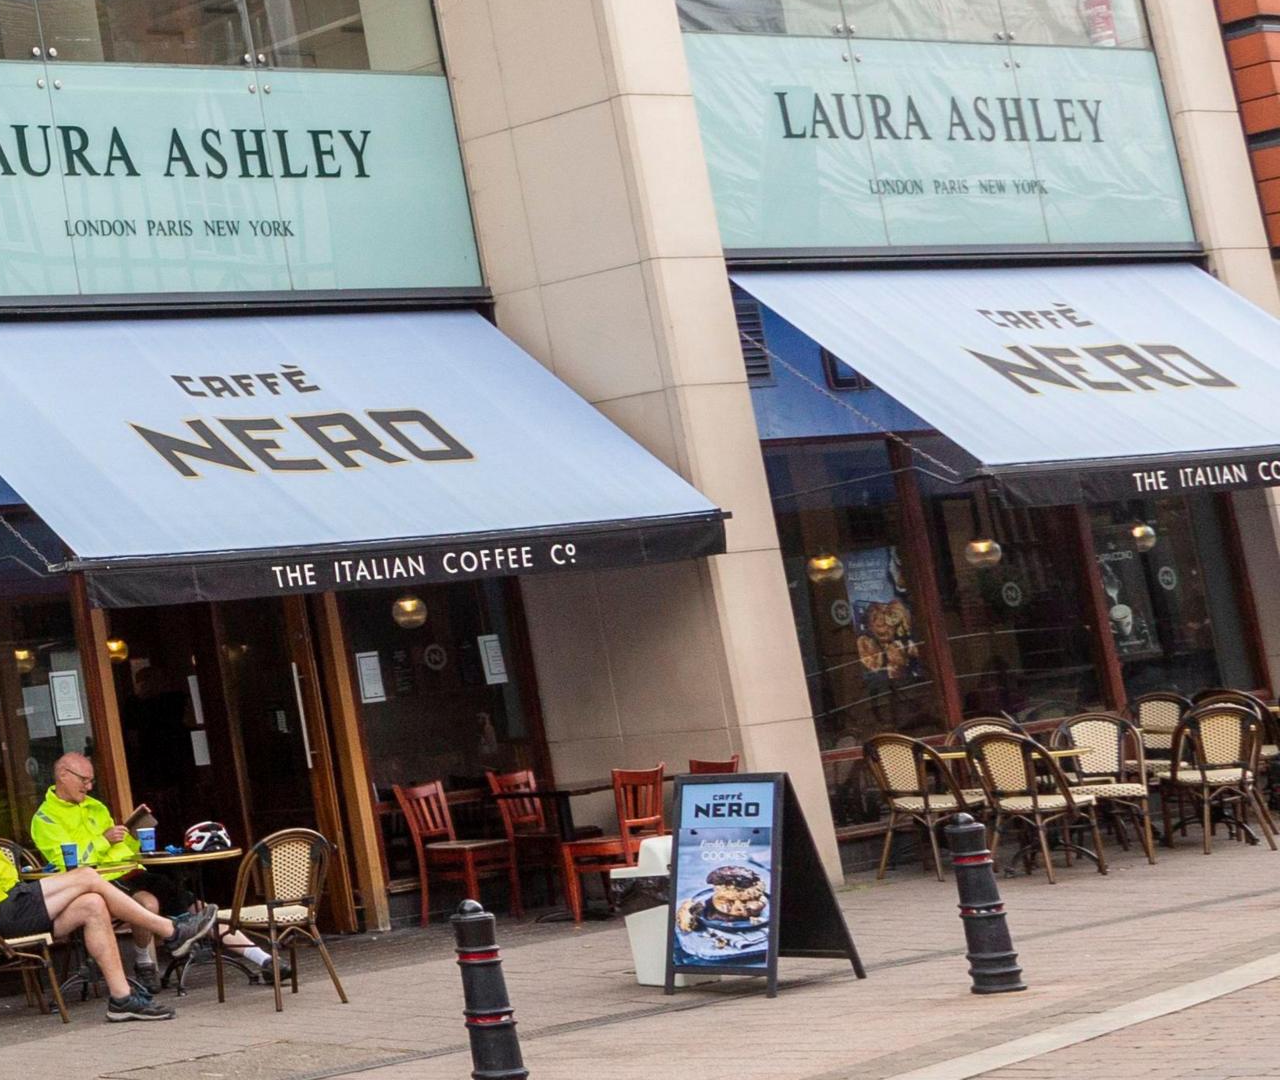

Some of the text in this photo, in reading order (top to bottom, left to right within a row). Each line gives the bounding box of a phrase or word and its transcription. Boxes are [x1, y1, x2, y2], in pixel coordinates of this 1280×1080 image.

[774, 91, 1104, 144] LAURA ASHLEY
[164, 128, 372, 179] ASHLEY
[869, 178, 1049, 196] LONDON PARIS NEW YORK
[64, 218, 295, 238] LONDON PARIS NEW YORK
[976, 302, 1093, 330] CAFFÈ
[171, 363, 322, 399] CAFFÈ
[964, 343, 1239, 397] NERO
[126, 407, 477, 480] NERO
[1132, 470, 1169, 492] THE
[1179, 464, 1249, 488] ITALIAN
[271, 563, 317, 589] THE
[335, 554, 425, 584] ITALIAN
[443, 545, 533, 573] COFFEE
[694, 802, 760, 818] NERO
[701, 851, 749, 861] COOKIES
